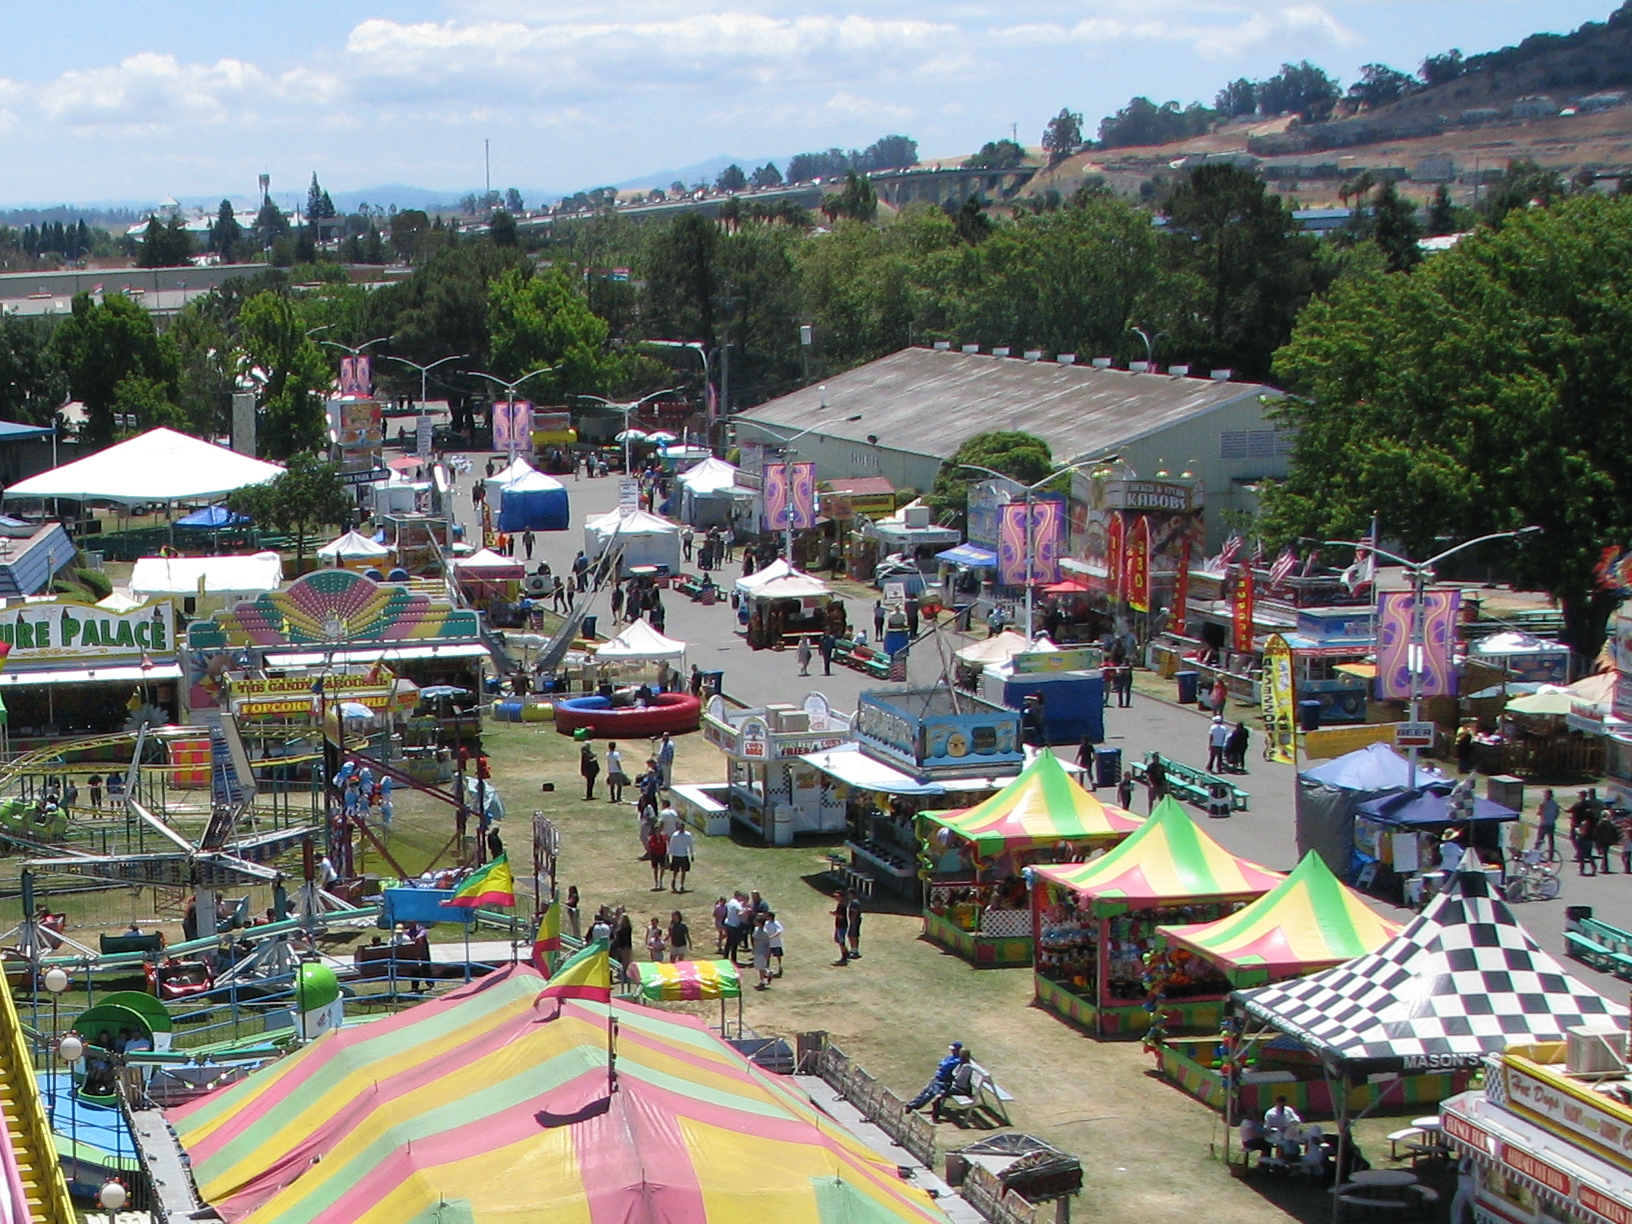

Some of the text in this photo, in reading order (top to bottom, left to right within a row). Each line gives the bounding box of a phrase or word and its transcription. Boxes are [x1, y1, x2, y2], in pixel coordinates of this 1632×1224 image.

[1128, 492, 1186, 510] KABOBS
[61, 618, 167, 650] PALACE
[1403, 1052, 1479, 1069] MASON'S
